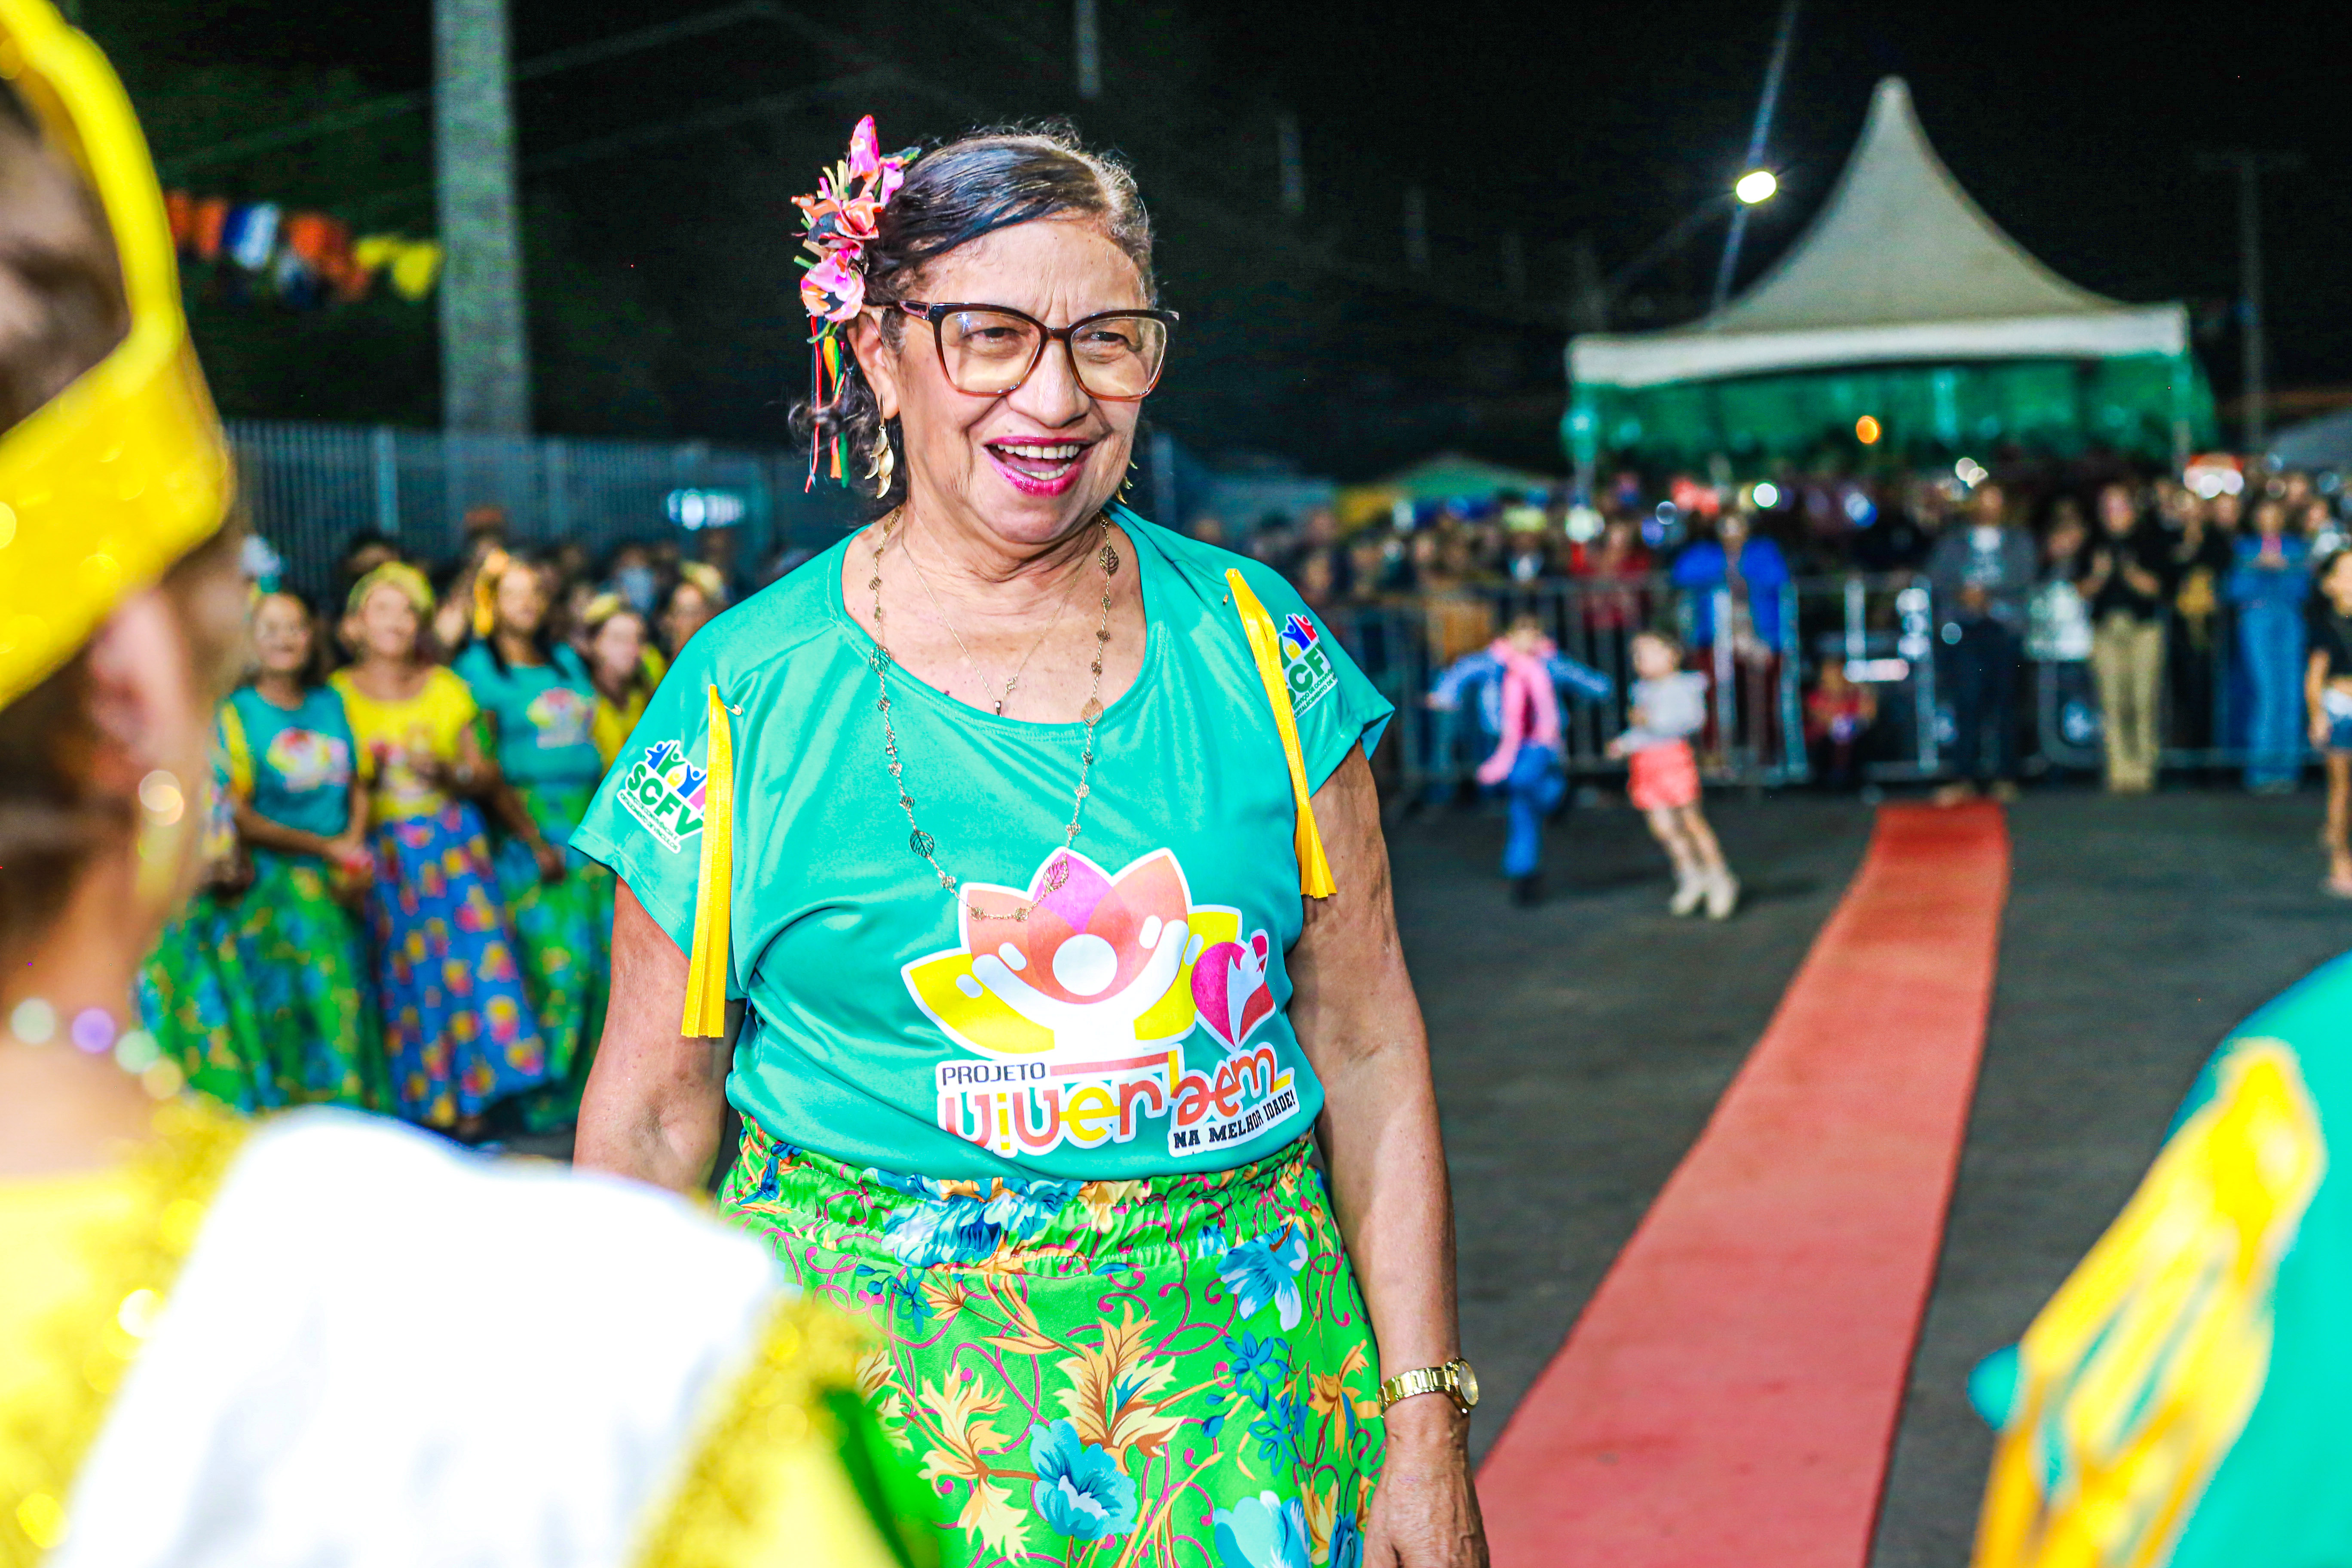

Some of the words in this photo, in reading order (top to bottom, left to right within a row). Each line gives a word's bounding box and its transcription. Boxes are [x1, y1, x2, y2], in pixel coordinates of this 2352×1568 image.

[1294, 684, 1327, 718] ORTALECIMENTO
[627, 764, 703, 836] SCFV
[942, 1062, 1045, 1086] PROJETO
[1174, 1130, 1200, 1149] NA
[1209, 1110, 1264, 1143] MELHOR
[1263, 1090, 1296, 1122] IDADE!
